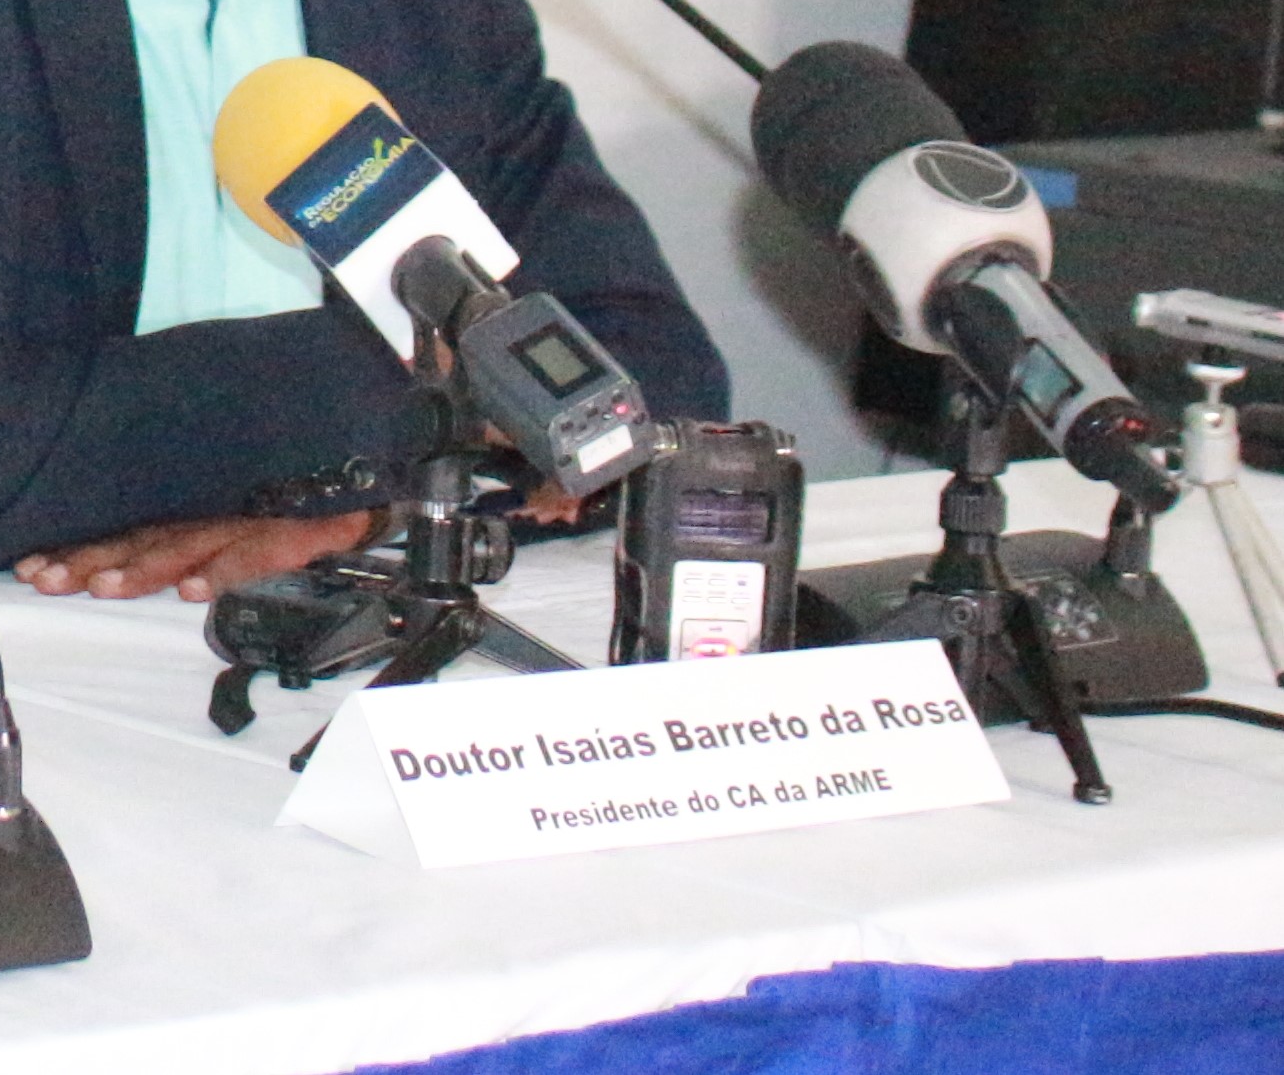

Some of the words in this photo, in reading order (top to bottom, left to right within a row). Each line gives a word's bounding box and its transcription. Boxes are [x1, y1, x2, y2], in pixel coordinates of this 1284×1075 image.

[389, 742, 525, 782] Doutor
[535, 728, 657, 766] Isaías
[663, 711, 809, 753] Barreto
[819, 704, 867, 736] da
[871, 698, 968, 730] Rosa
[530, 797, 679, 831] Presidente
[687, 790, 720, 814] do
[726, 783, 768, 809] CA
[774, 780, 808, 803] da
[815, 768, 893, 799] ARME
